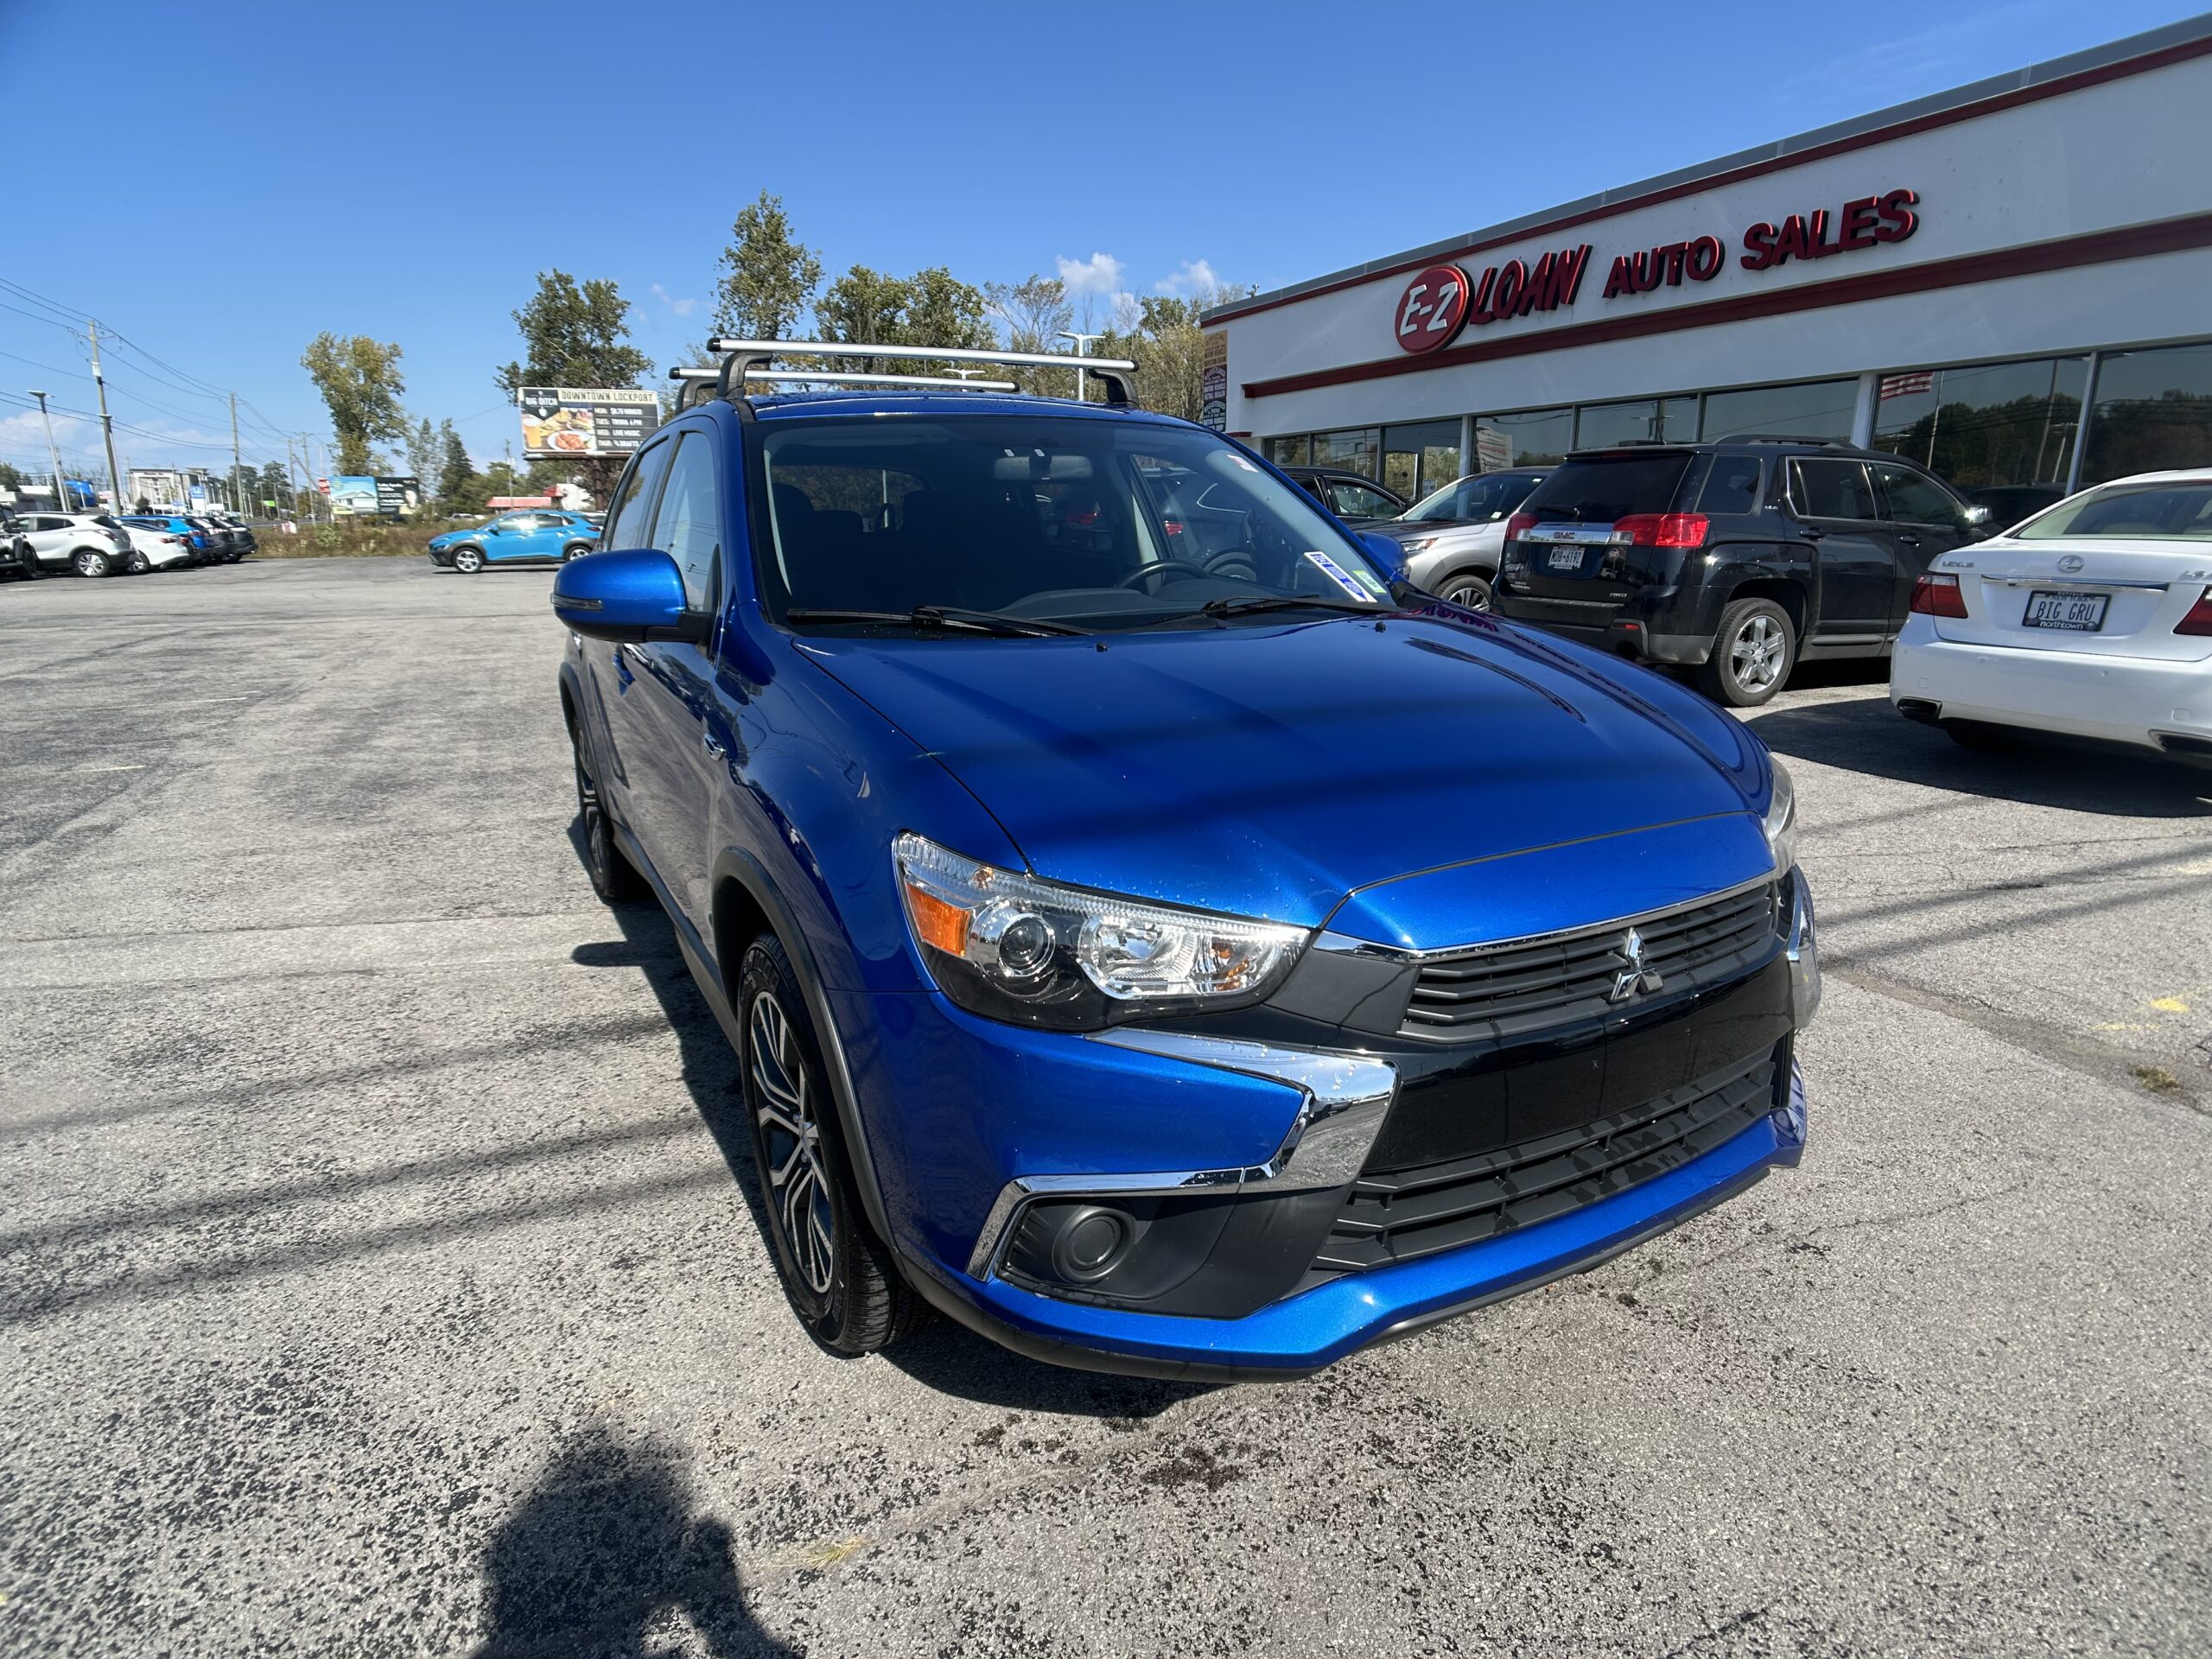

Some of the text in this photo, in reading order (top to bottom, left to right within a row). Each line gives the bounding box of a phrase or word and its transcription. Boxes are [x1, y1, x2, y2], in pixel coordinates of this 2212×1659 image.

[1400, 188, 1920, 336] E-Z LOAN AUTO SALES
[562, 391, 653, 401] DOWNTOWN LOCKPORT
[525, 397, 558, 406] BIG DITCH
[2037, 601, 2096, 621] BIG GRU
[2039, 620, 2083, 630] northtown
